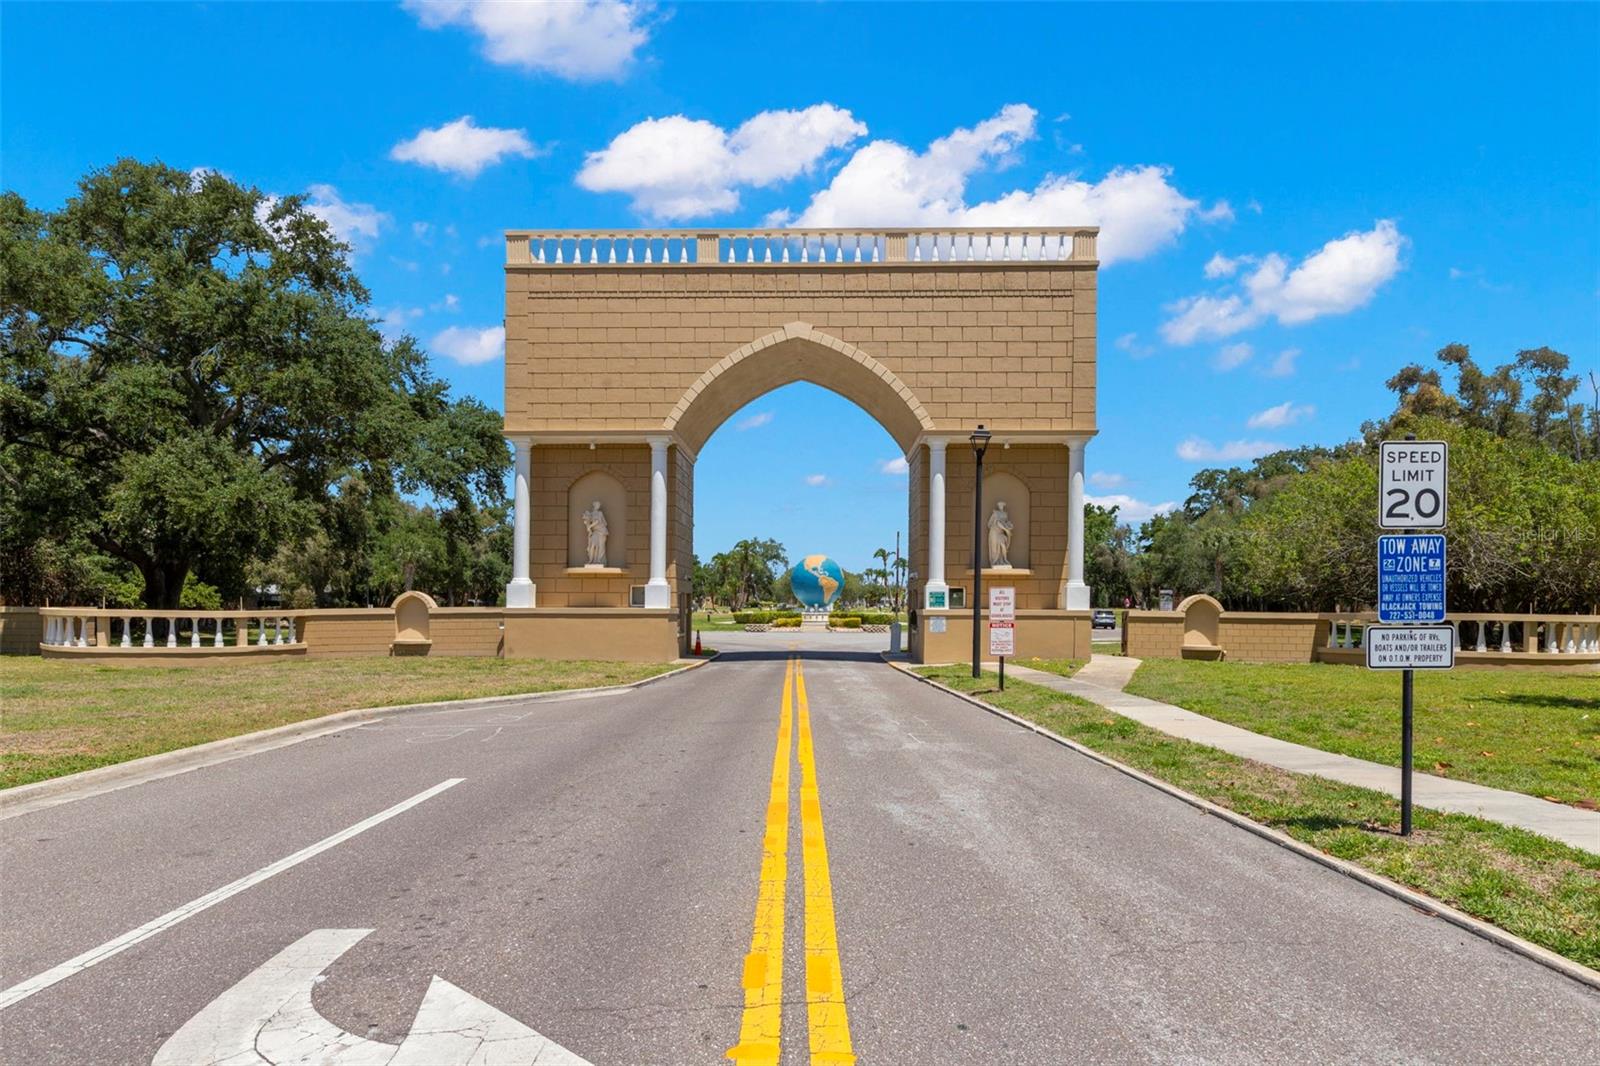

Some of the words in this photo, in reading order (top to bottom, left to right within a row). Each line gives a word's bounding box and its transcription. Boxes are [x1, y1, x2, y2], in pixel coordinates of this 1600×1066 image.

[1387, 451, 1441, 463] SPEED
[1392, 470, 1434, 481] LIMIT
[1386, 488, 1440, 518] 20
[1382, 538, 1406, 554] TOW
[1411, 538, 1441, 554] AWAY
[1396, 556, 1427, 572] ZONE
[1381, 574, 1418, 583] UNAUTHORIZED
[1419, 574, 1442, 582] VEHICLES
[1381, 583, 1389, 592] OR
[1390, 583, 1408, 592] VESSELS
[1409, 583, 1419, 592] WILL
[1420, 583, 1426, 592] BE
[1395, 593, 1401, 602] AT
[1421, 593, 1442, 602] EXPENSE
[1381, 602, 1417, 611] BLACKJACK
[1419, 602, 1443, 611] TOWING
[1382, 633, 1390, 641] NO
[1392, 633, 1417, 641] PARKING
[1419, 633, 1427, 641] OF
[1374, 644, 1393, 652] BOATS
[1394, 644, 1419, 653] AND/OR
[1420, 644, 1447, 652] TRAILERS
[1413, 655, 1443, 663] PROPERTY
